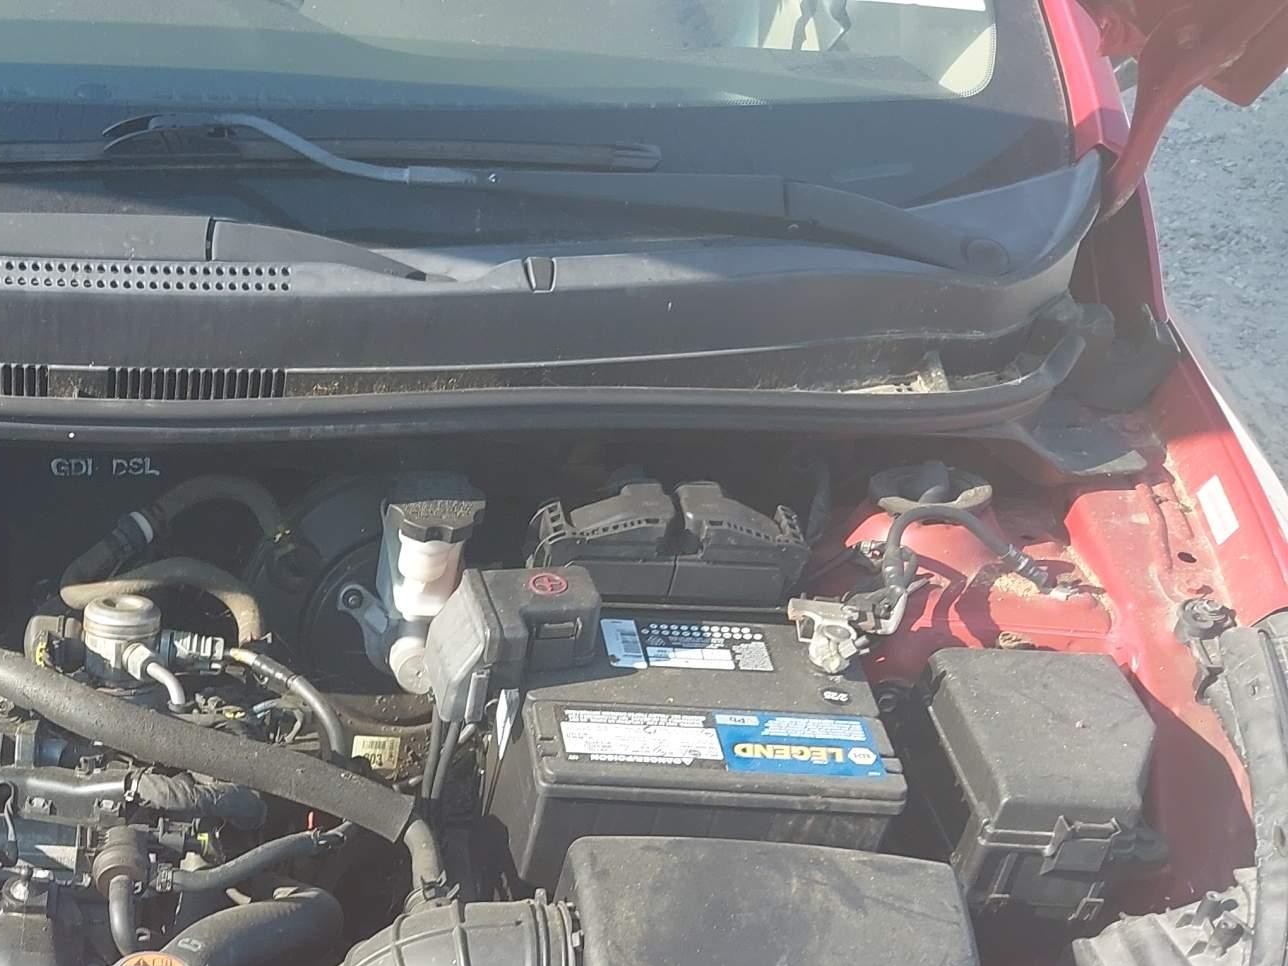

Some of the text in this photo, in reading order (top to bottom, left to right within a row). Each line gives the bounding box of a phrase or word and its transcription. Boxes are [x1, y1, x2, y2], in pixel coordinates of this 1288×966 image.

[50, 456, 161, 476] GDI DSL
[734, 743, 845, 764] LEGEND
